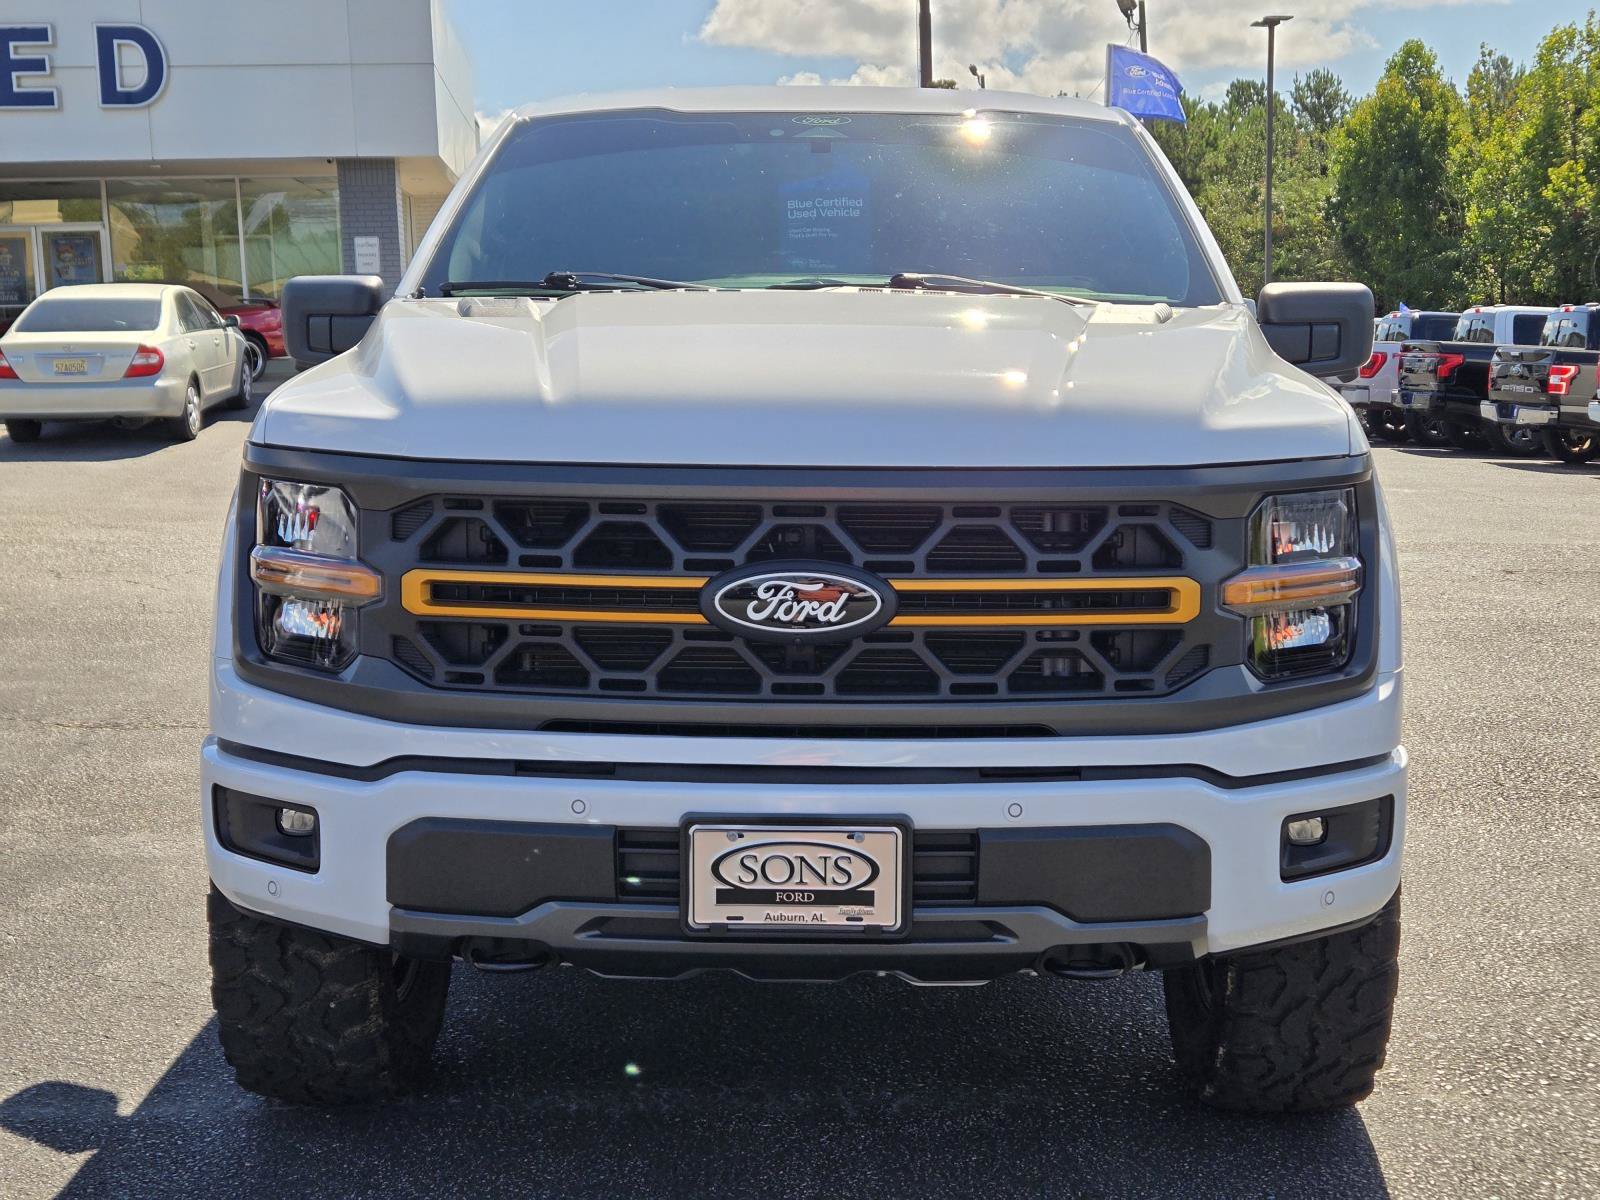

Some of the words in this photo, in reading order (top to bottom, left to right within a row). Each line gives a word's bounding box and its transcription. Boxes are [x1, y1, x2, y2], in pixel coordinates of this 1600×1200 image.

[0, 22, 169, 109] ED
[787, 199, 813, 209] Blue
[815, 196, 863, 207] Certified
[787, 209, 817, 219] Used
[819, 207, 861, 217] Vehicle
[746, 580, 849, 623] Ford
[738, 854, 852, 886] SONS
[776, 892, 815, 902] FORD
[764, 912, 808, 923] Auburn,
[811, 913, 826, 923] AL
